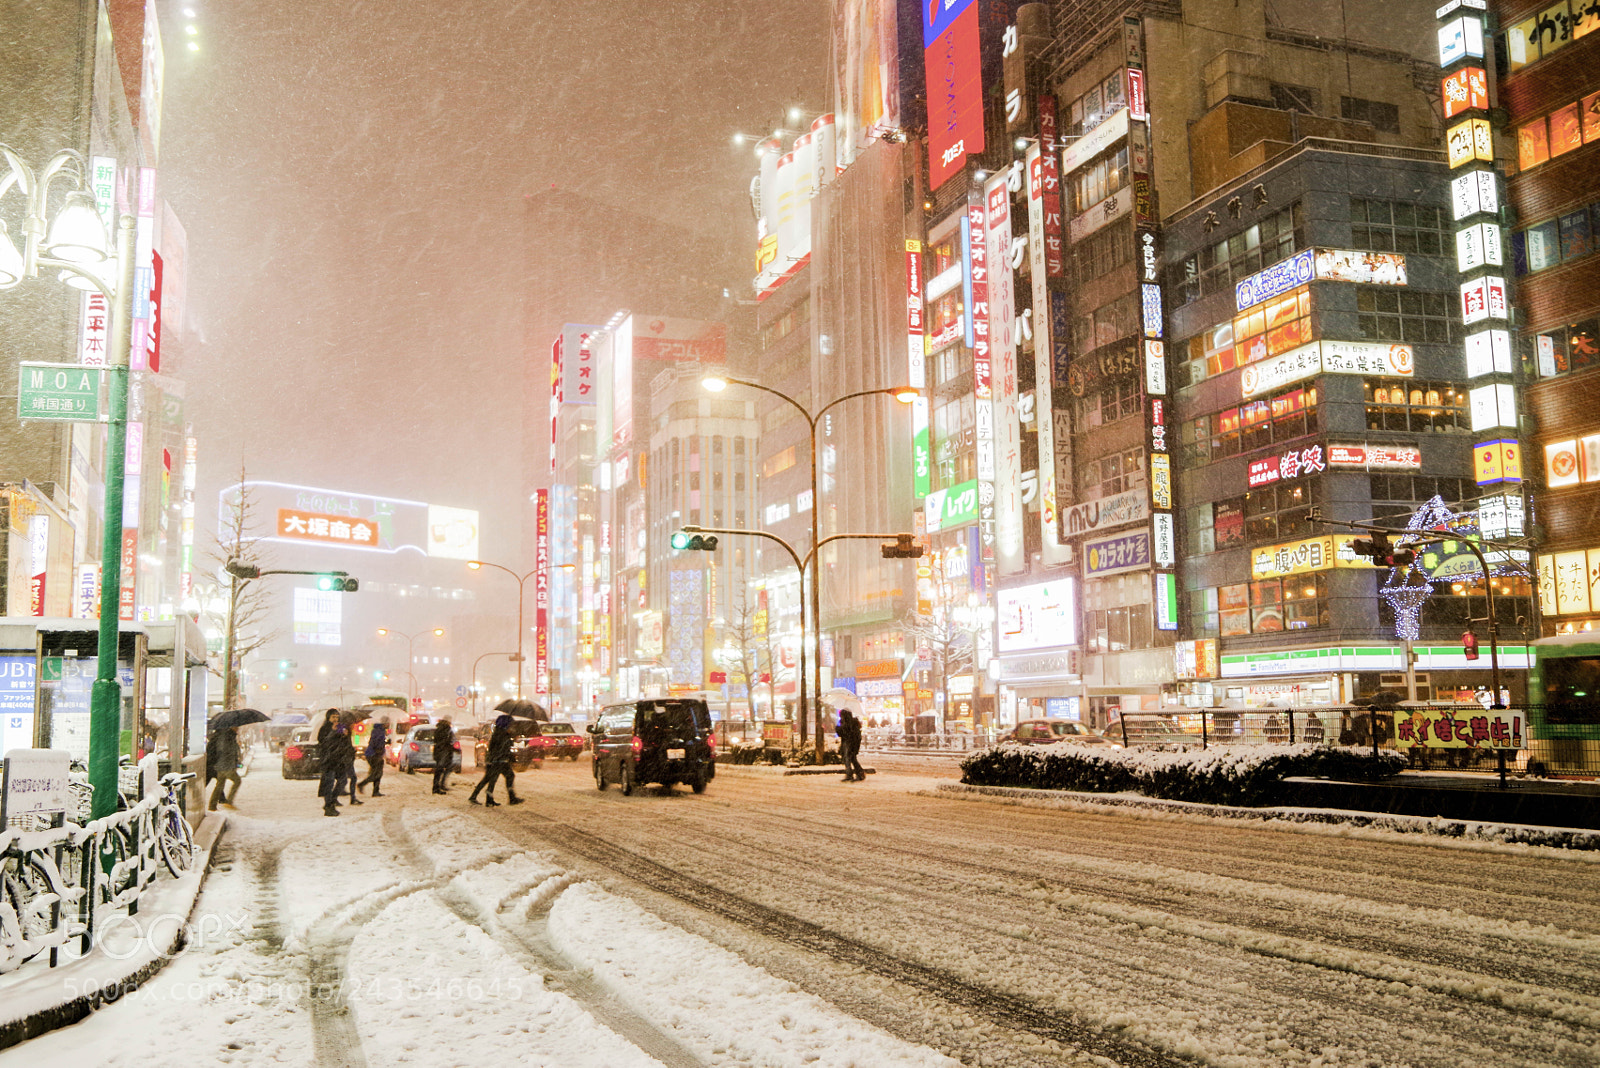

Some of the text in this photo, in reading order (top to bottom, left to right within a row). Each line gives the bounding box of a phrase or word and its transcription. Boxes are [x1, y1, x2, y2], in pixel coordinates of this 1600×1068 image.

[1042, 112, 1062, 274] カラオケ パセラ
[971, 210, 988, 280] カラオケ
[974, 302, 993, 354] パセラ
[32, 397, 87, 411] 靖国通り
[916, 445, 928, 477] レイク
[1280, 444, 1325, 479] 海峡
[947, 488, 976, 518] レイク
[284, 515, 372, 541] 大塚商会
[1099, 538, 1134, 568] カラオケ
[1275, 541, 1322, 573] 腹八分目
[1444, 559, 1482, 573] さくら通り
[80, 572, 95, 618] 三平ス
[1567, 562, 1583, 602] 牛たん
